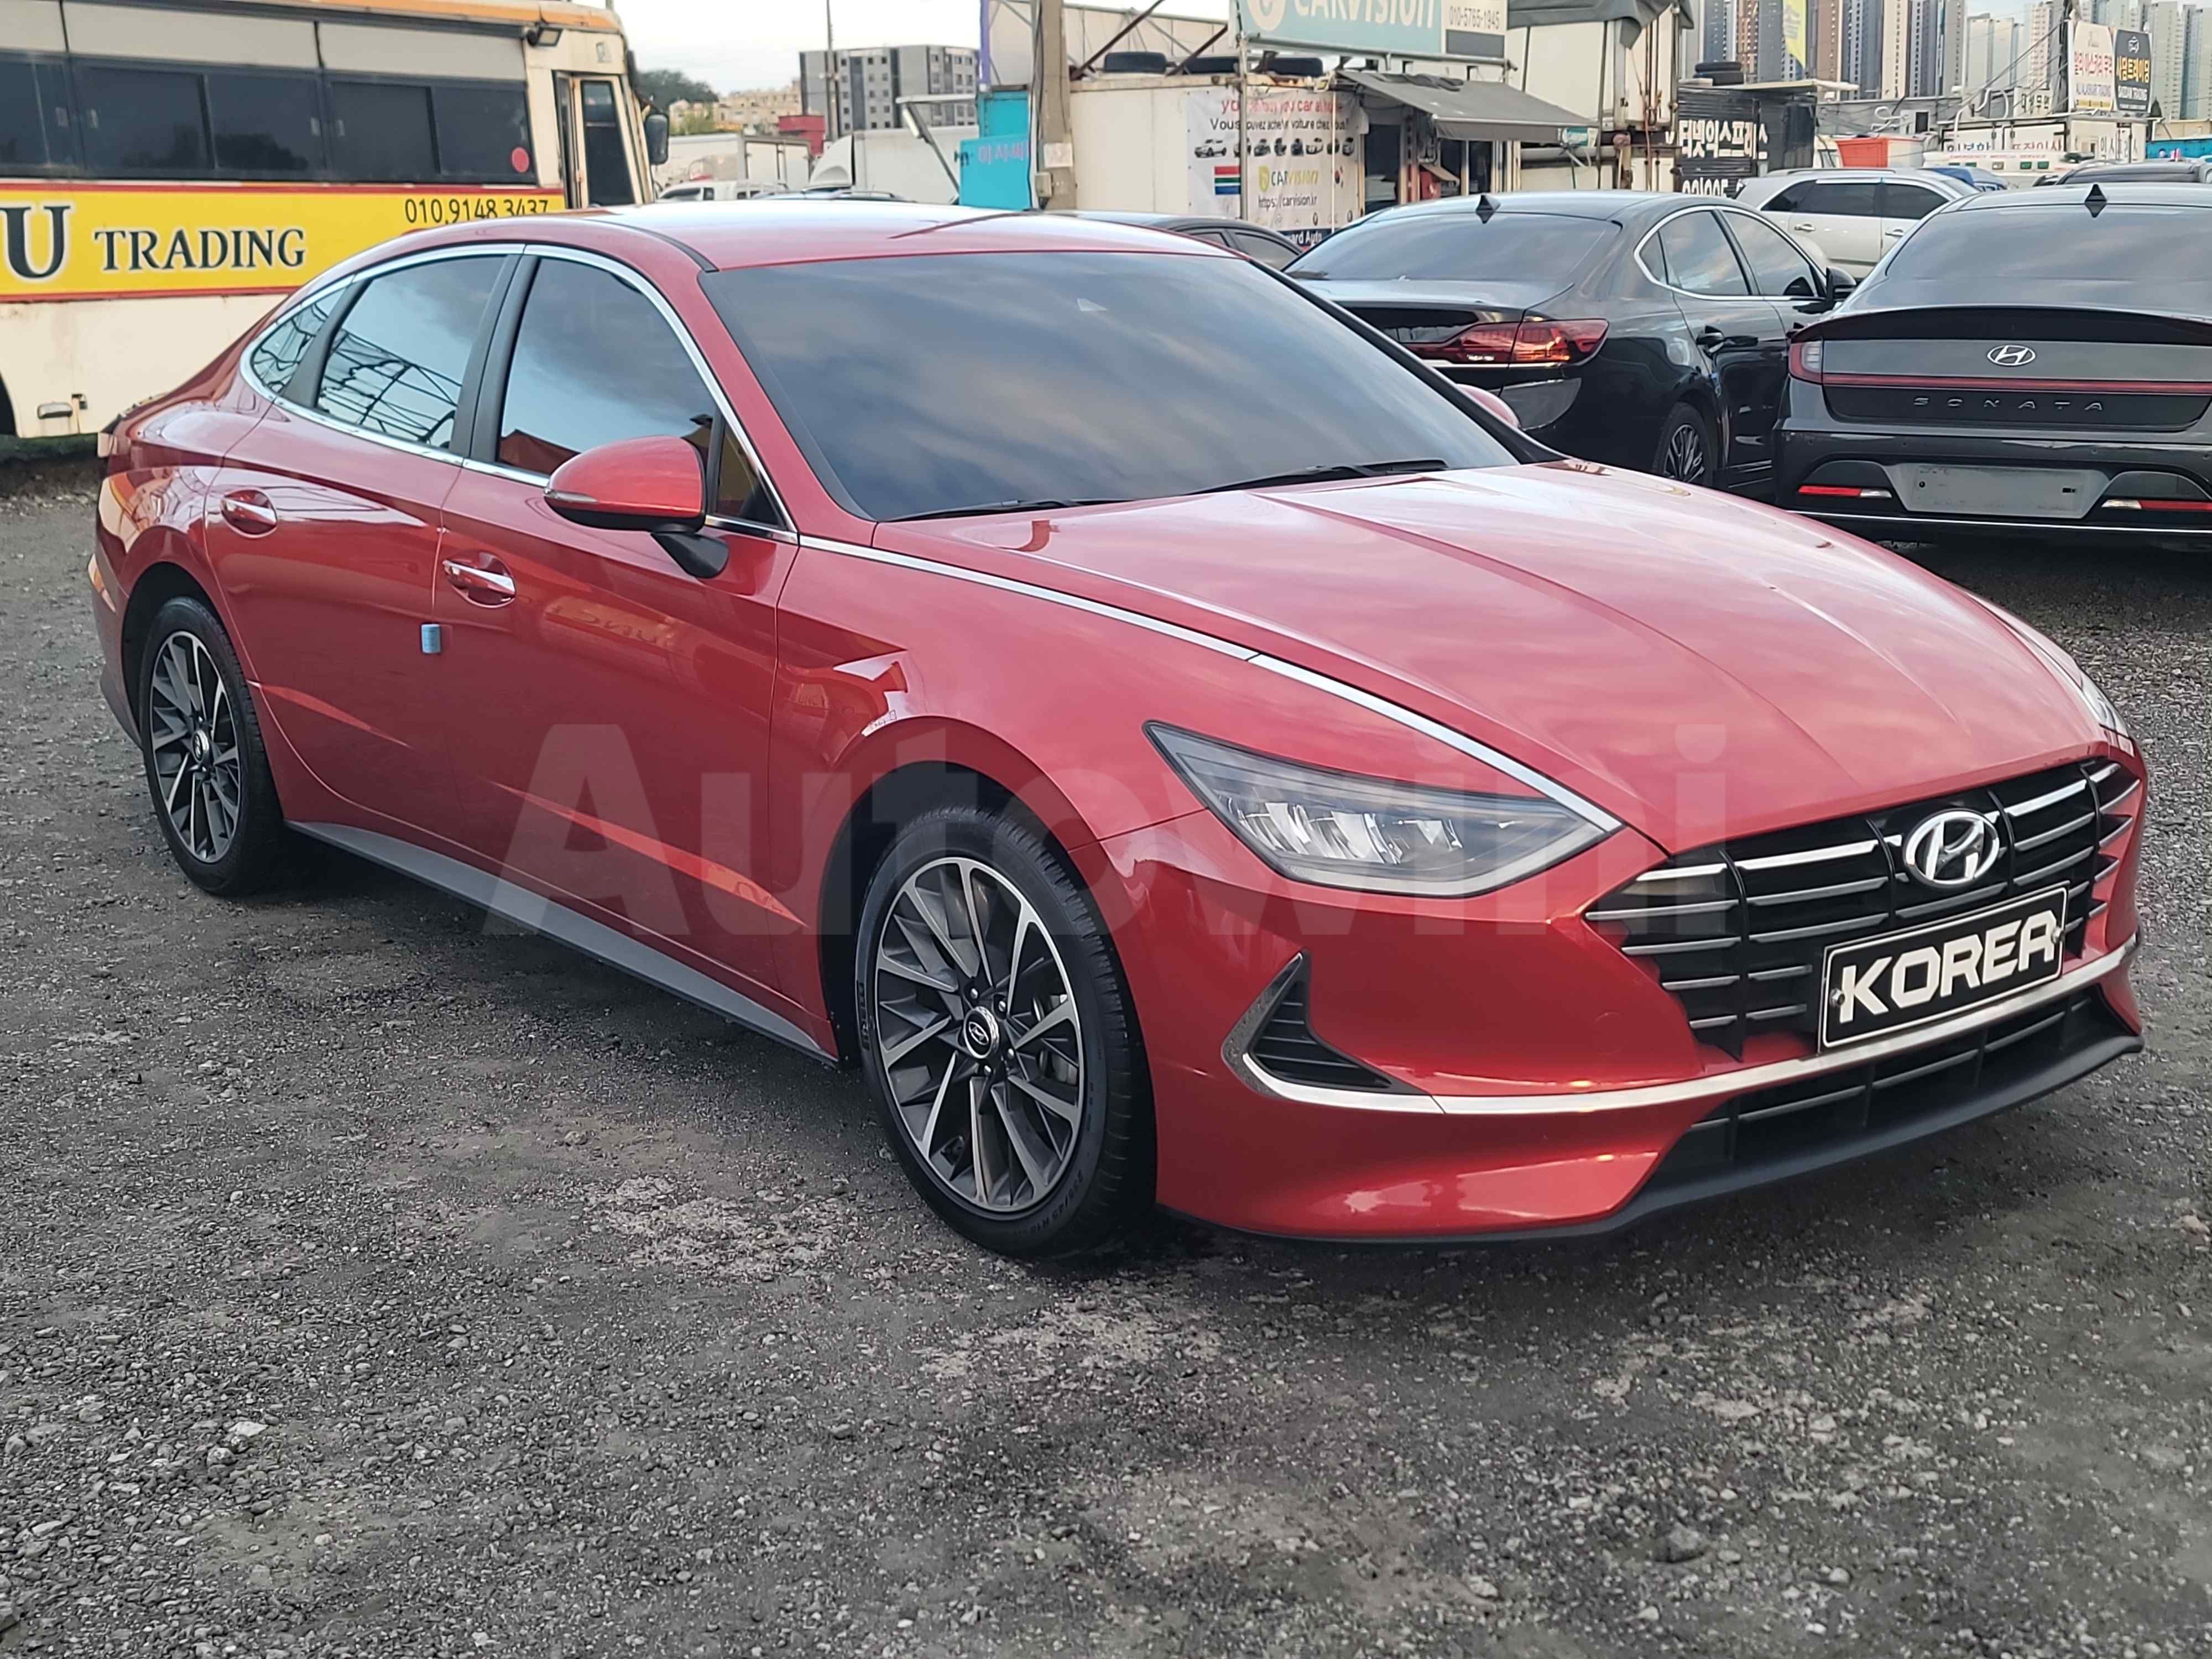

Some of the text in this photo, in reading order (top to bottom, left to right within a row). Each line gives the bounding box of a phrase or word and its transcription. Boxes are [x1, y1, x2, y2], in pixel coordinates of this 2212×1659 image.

[95, 228, 305, 271] TRADING
[1913, 397, 2103, 410] SONATA
[1839, 910, 2058, 1024] KOREA
